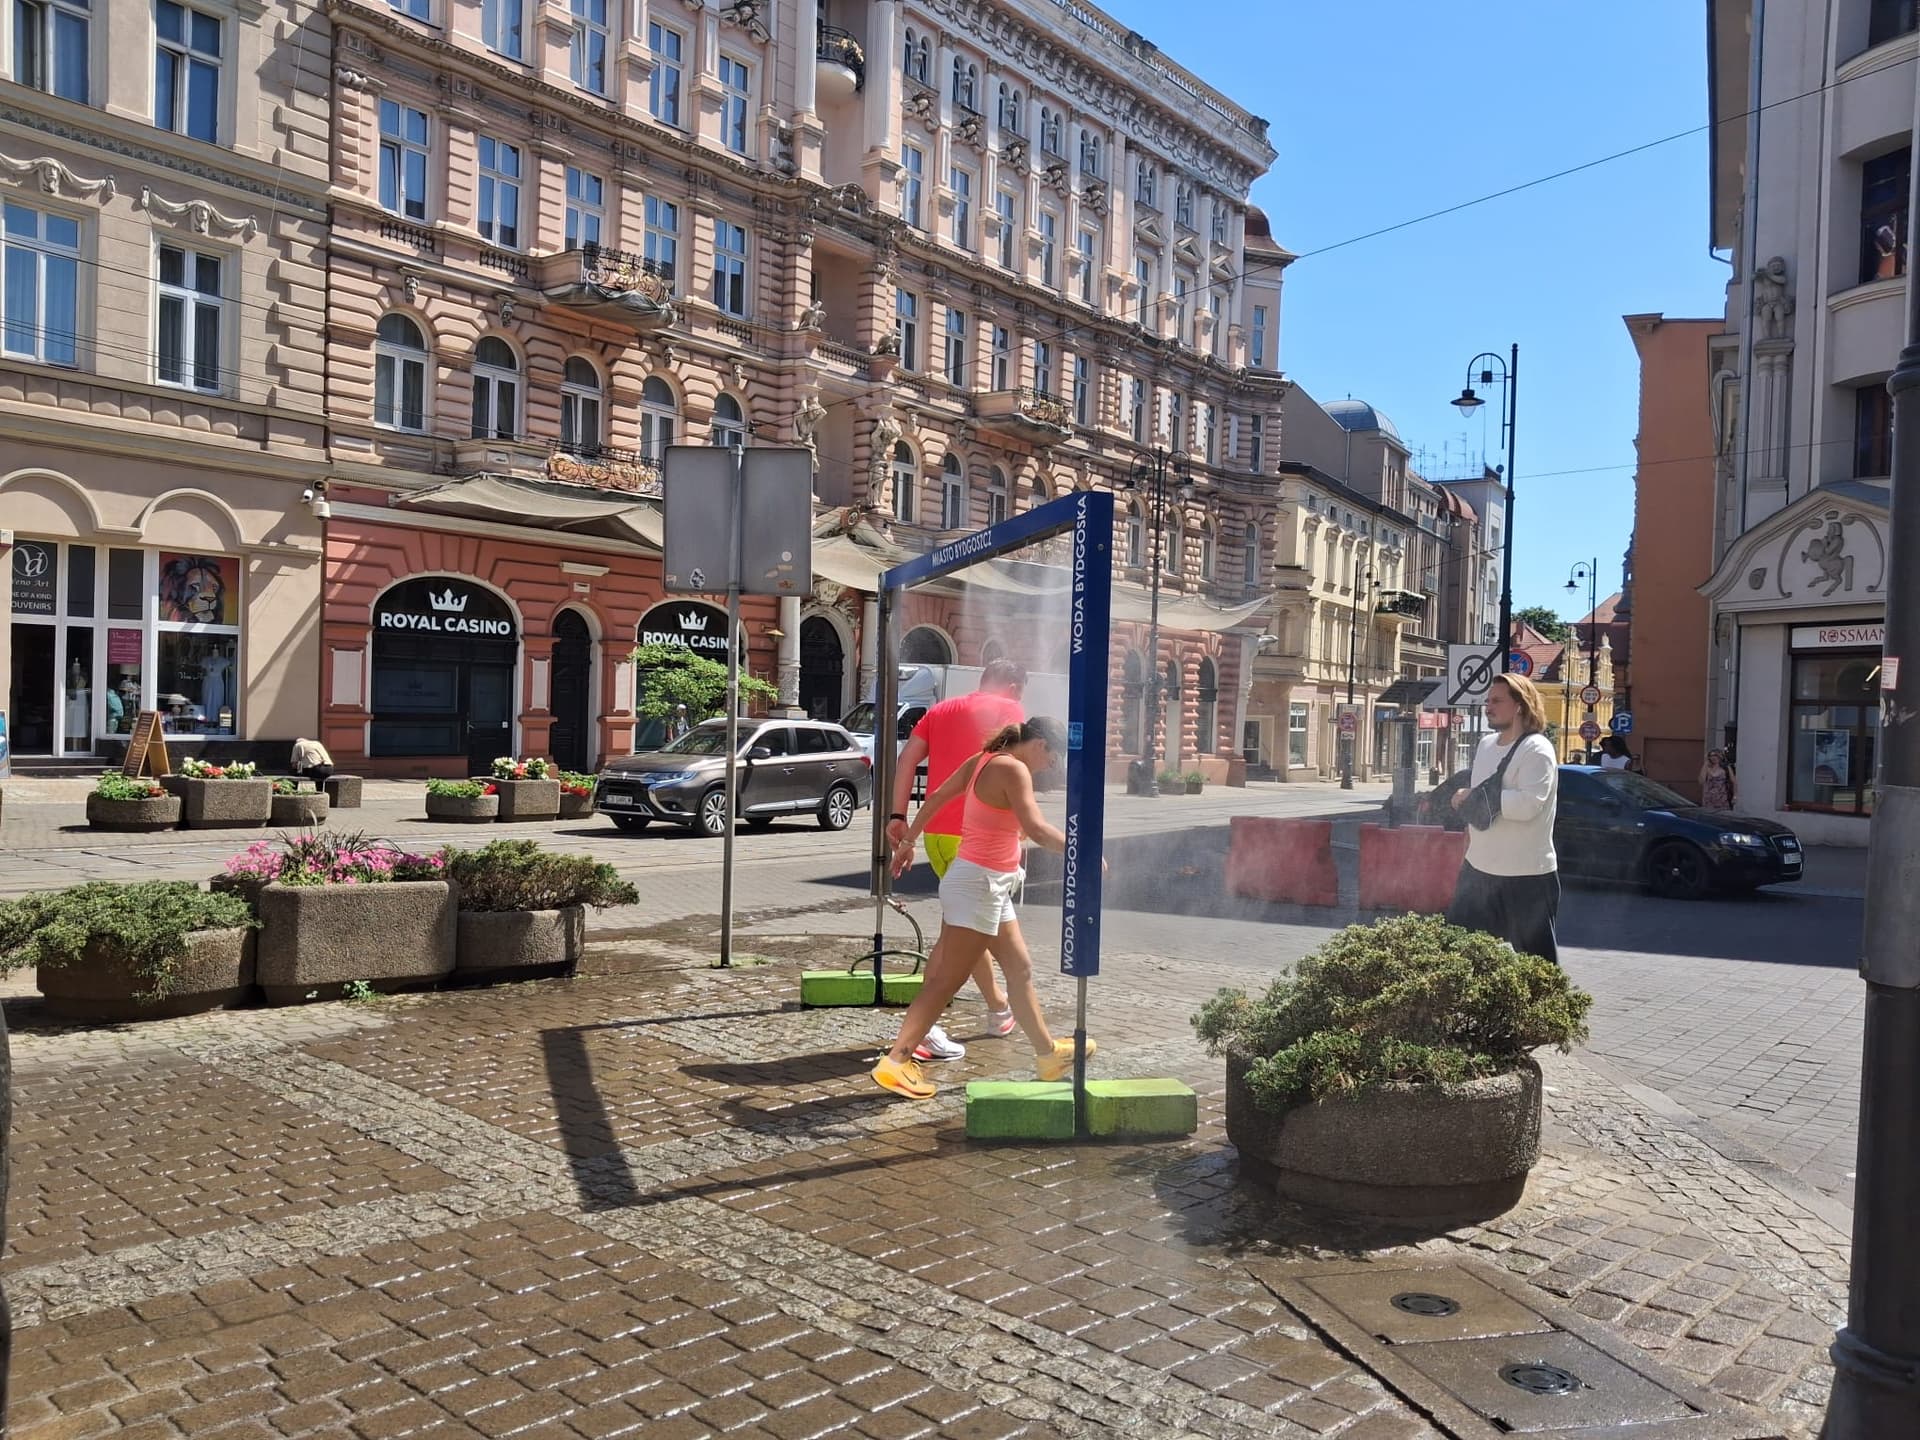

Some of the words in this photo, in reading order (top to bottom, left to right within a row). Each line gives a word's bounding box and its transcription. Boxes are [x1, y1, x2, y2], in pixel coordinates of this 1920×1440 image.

[932, 545, 954, 568] MIASTO
[955, 530, 992, 559] BYDGOSZCZ
[1075, 495, 1087, 592] BYDGOSKA
[11, 600, 52, 610] OUVENIRS
[380, 612, 441, 631] ROYAL
[444, 617, 511, 635] CASINO
[1073, 597, 1084, 653] WODA
[643, 631, 688, 647] ROYAL
[690, 635, 729, 650] CASIN
[1463, 665, 1488, 684] 30
[1615, 716, 1629, 731] P
[1066, 813, 1078, 908] BYDGOSKA
[1064, 914, 1075, 970] WODA
